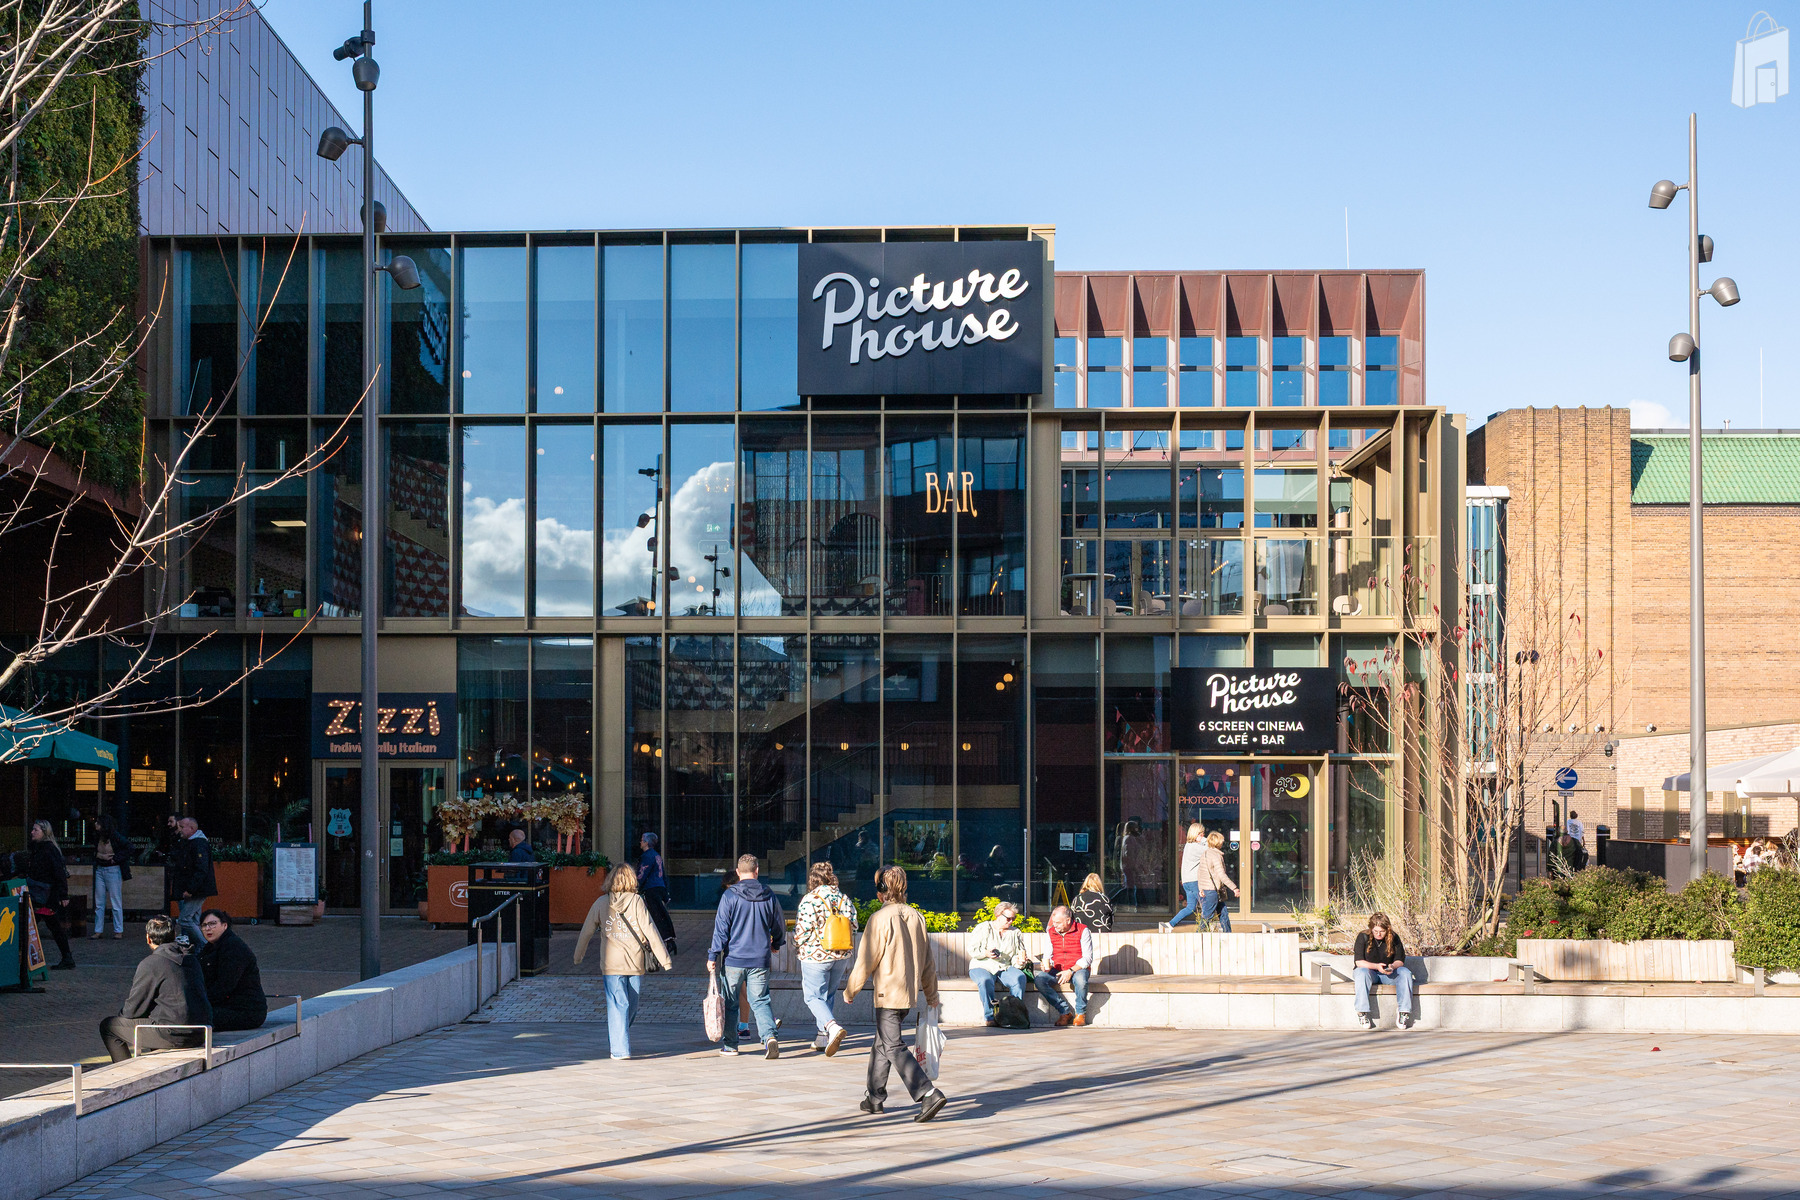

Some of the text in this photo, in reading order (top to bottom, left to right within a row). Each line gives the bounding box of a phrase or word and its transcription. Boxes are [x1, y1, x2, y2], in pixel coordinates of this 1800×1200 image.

[813, 268, 1029, 350] Picture
[850, 309, 1020, 364] house
[925, 471, 978, 518] BAR
[1206, 672, 1302, 708] Picture
[1222, 690, 1298, 714] house
[324, 699, 441, 736] Zzzi
[1199, 721, 1305, 732] 6 SCREEN CINEMA
[329, 741, 437, 755] Indivially Italian
[1217, 732, 1286, 745] CAFÉ BAR
[1178, 795, 1240, 805] PHOTOBOOTH
